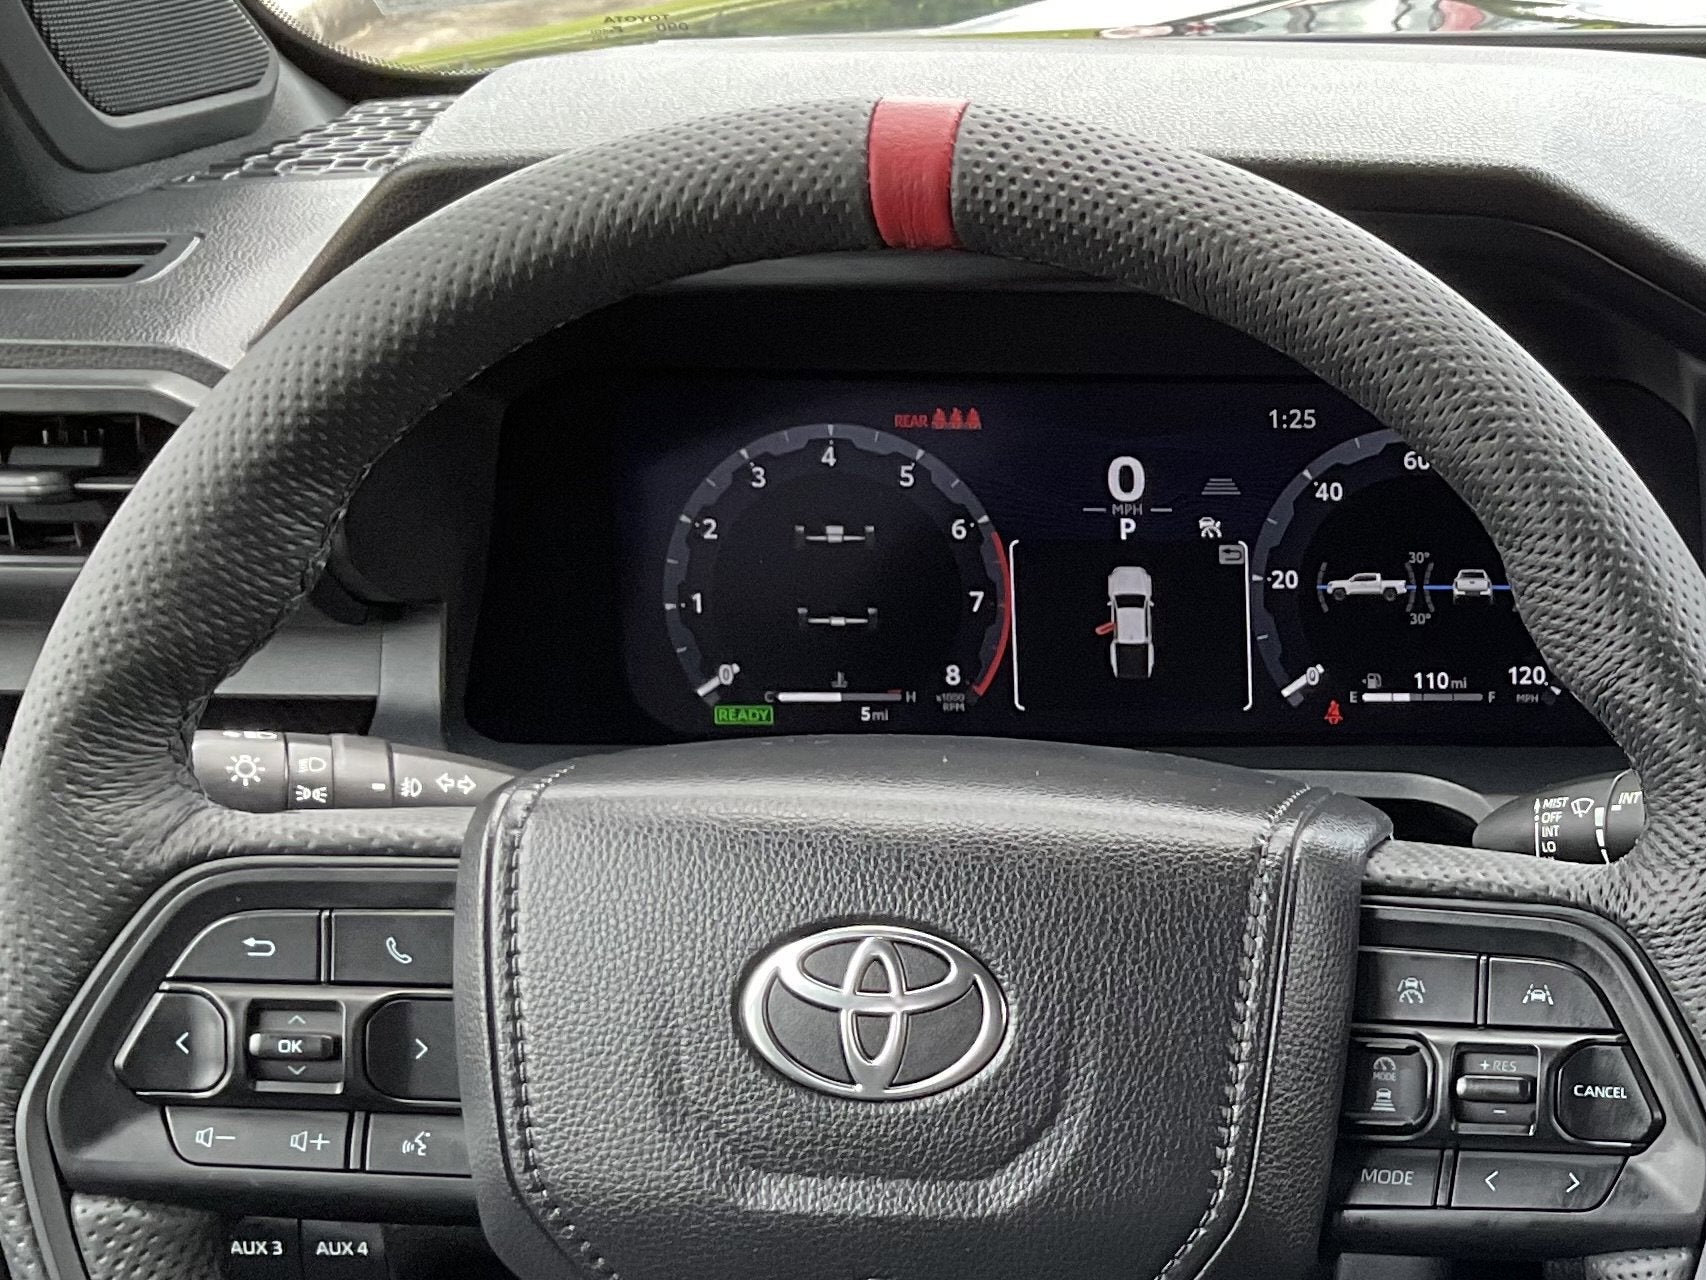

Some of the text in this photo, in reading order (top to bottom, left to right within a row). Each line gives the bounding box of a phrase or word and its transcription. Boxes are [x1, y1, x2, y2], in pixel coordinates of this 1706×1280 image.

[894, 413, 929, 428] REAR
[1268, 409, 1317, 430] 1:25
[820, 445, 836, 467] 4
[751, 467, 767, 488] 3
[899, 466, 915, 487] 5
[1107, 455, 1145, 502] 0
[1315, 483, 1343, 501] 40
[1111, 503, 1143, 516] MPH
[703, 520, 719, 540] 2
[951, 519, 967, 540] 6
[1120, 517, 1136, 541] P
[1408, 551, 1431, 564] 30°
[1271, 570, 1299, 590] 20
[692, 593, 703, 614] 1
[968, 591, 985, 613] 7
[1409, 612, 1432, 626] 30°
[718, 664, 733, 686] 0
[945, 665, 961, 686] 8
[1306, 667, 1320, 686] 0
[1508, 666, 1546, 686] 120
[905, 690, 916, 703] H
[1349, 692, 1358, 703] E
[1488, 692, 1496, 703] F
[1516, 693, 1539, 704] MPH
[717, 707, 770, 723] READY
[942, 702, 966, 713] RPM
[1542, 797, 1569, 809] MIST
[1618, 791, 1643, 805] INT
[1541, 811, 1562, 823] OFF
[1541, 825, 1560, 838] INT
[1541, 840, 1556, 853] LO
[277, 1039, 303, 1054] OK
[1372, 1072, 1397, 1082] MODE
[1573, 1084, 1627, 1099] CANCEL
[1360, 1169, 1415, 1186] MODE
[230, 1240, 283, 1255] AUX 3
[316, 1241, 369, 1256] AUX 4
